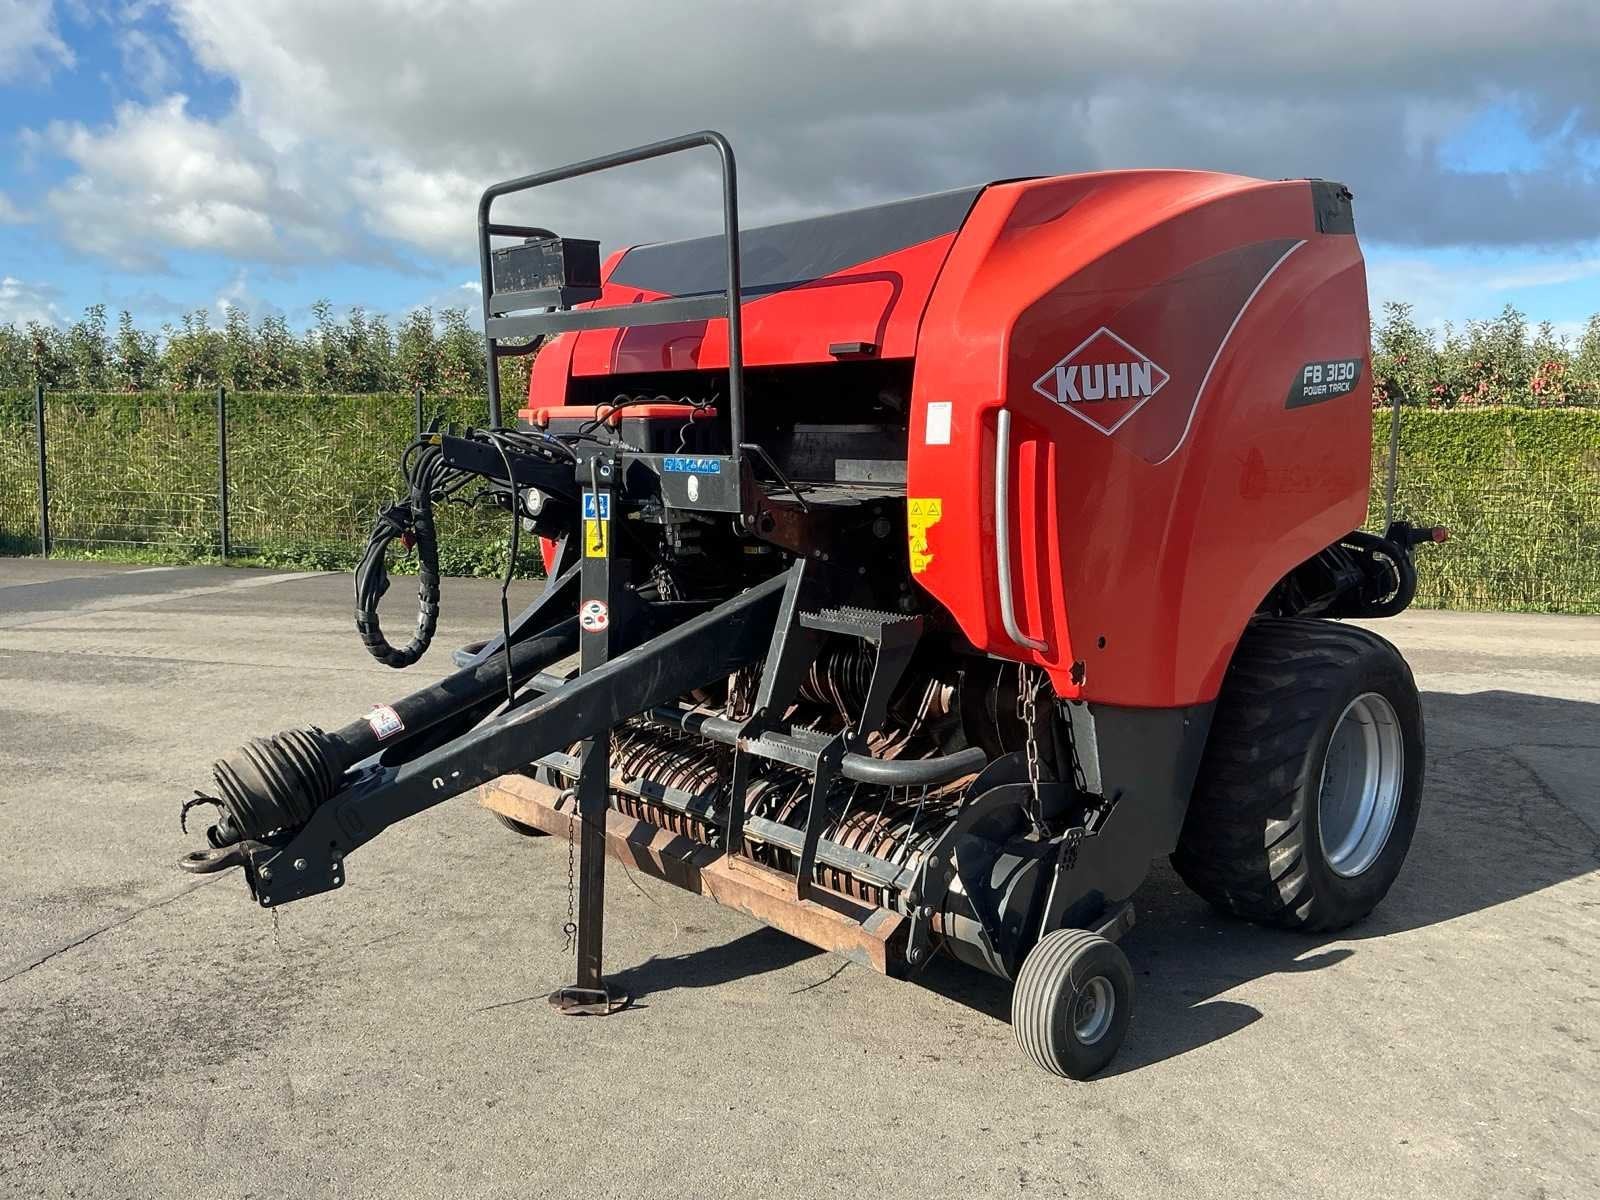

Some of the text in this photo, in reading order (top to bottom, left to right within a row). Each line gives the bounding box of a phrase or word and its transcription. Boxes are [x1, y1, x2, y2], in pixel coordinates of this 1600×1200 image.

[1056, 361, 1152, 403] KUHN
[1303, 362, 1355, 384] FB 3130
[1303, 382, 1350, 396] POWER TRACK
